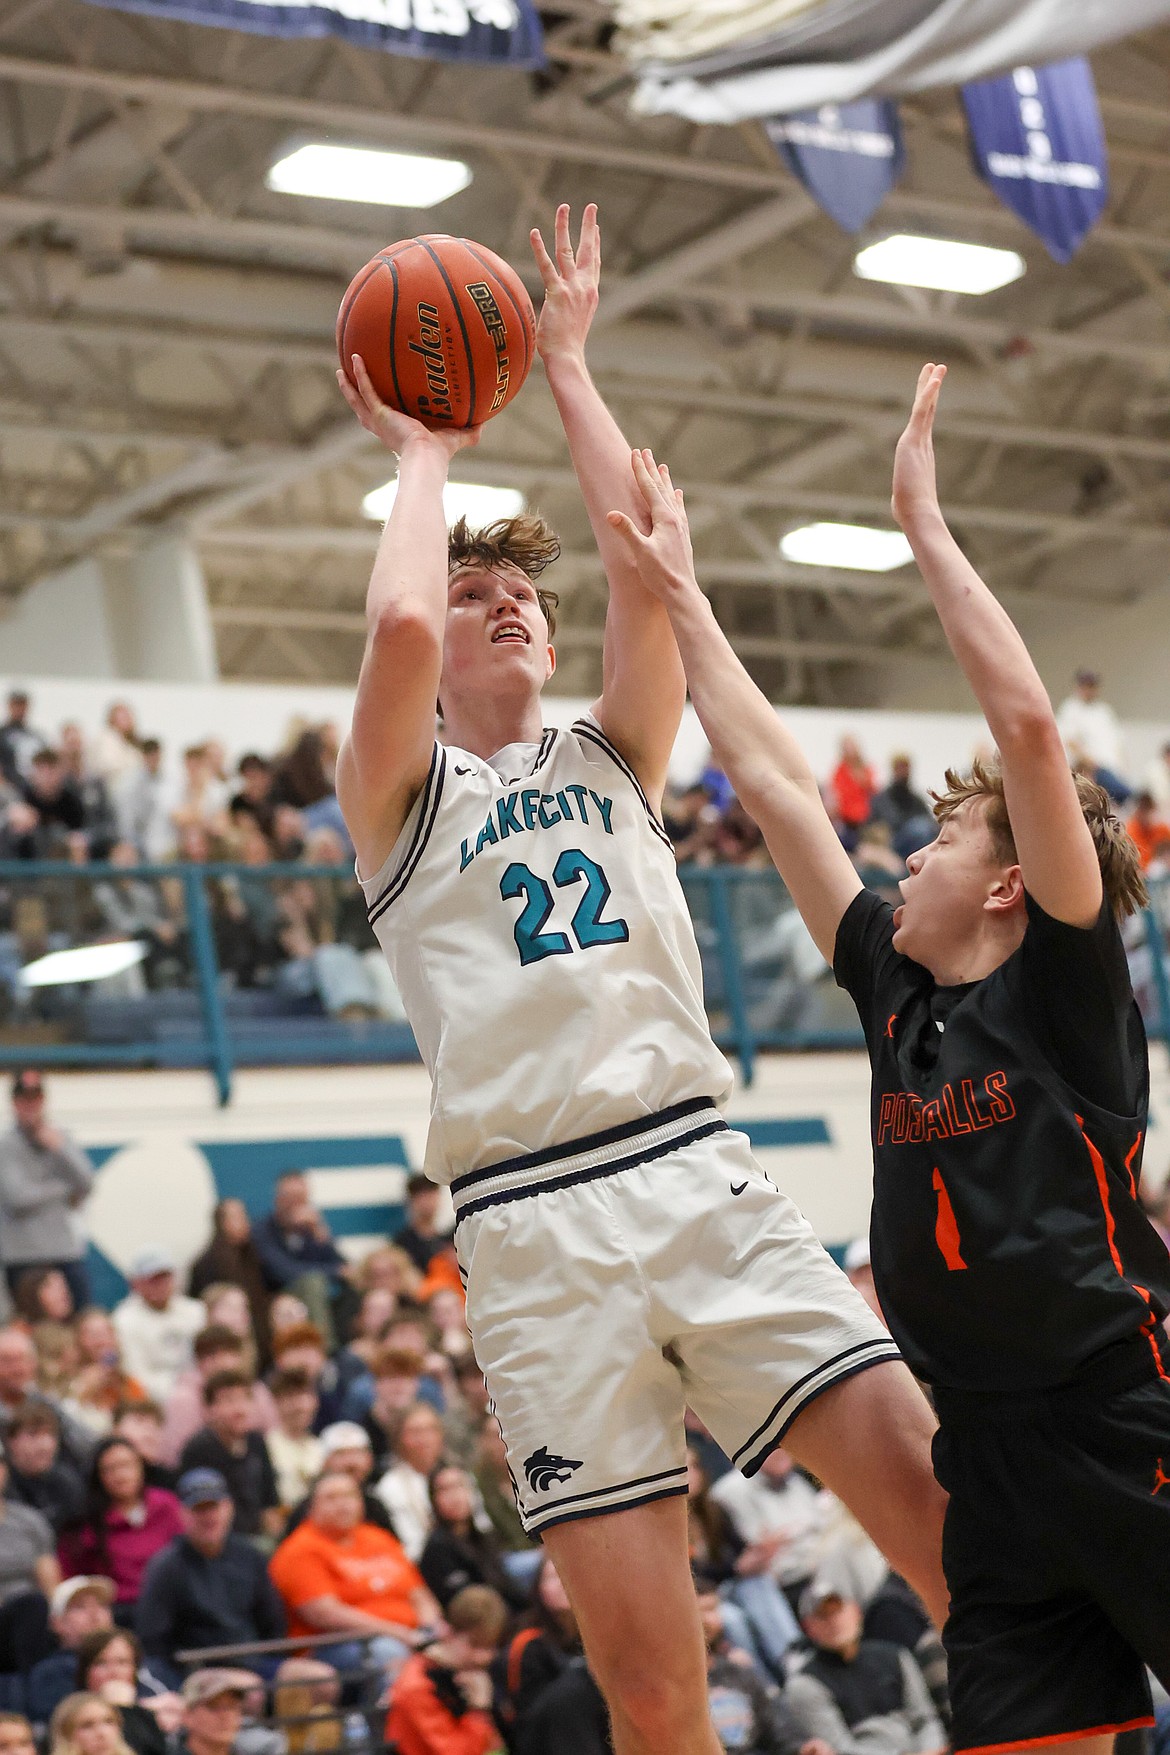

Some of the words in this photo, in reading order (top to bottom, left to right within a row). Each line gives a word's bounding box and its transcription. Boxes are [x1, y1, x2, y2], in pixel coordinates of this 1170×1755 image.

[468, 284, 505, 332] PRO
[408, 301, 454, 420] Baden
[459, 789, 540, 874] LAKE
[538, 784, 614, 836] CITY
[500, 848, 630, 967] 22
[921, 1070, 1017, 1142] ALLS
[931, 1166, 968, 1272] 1
